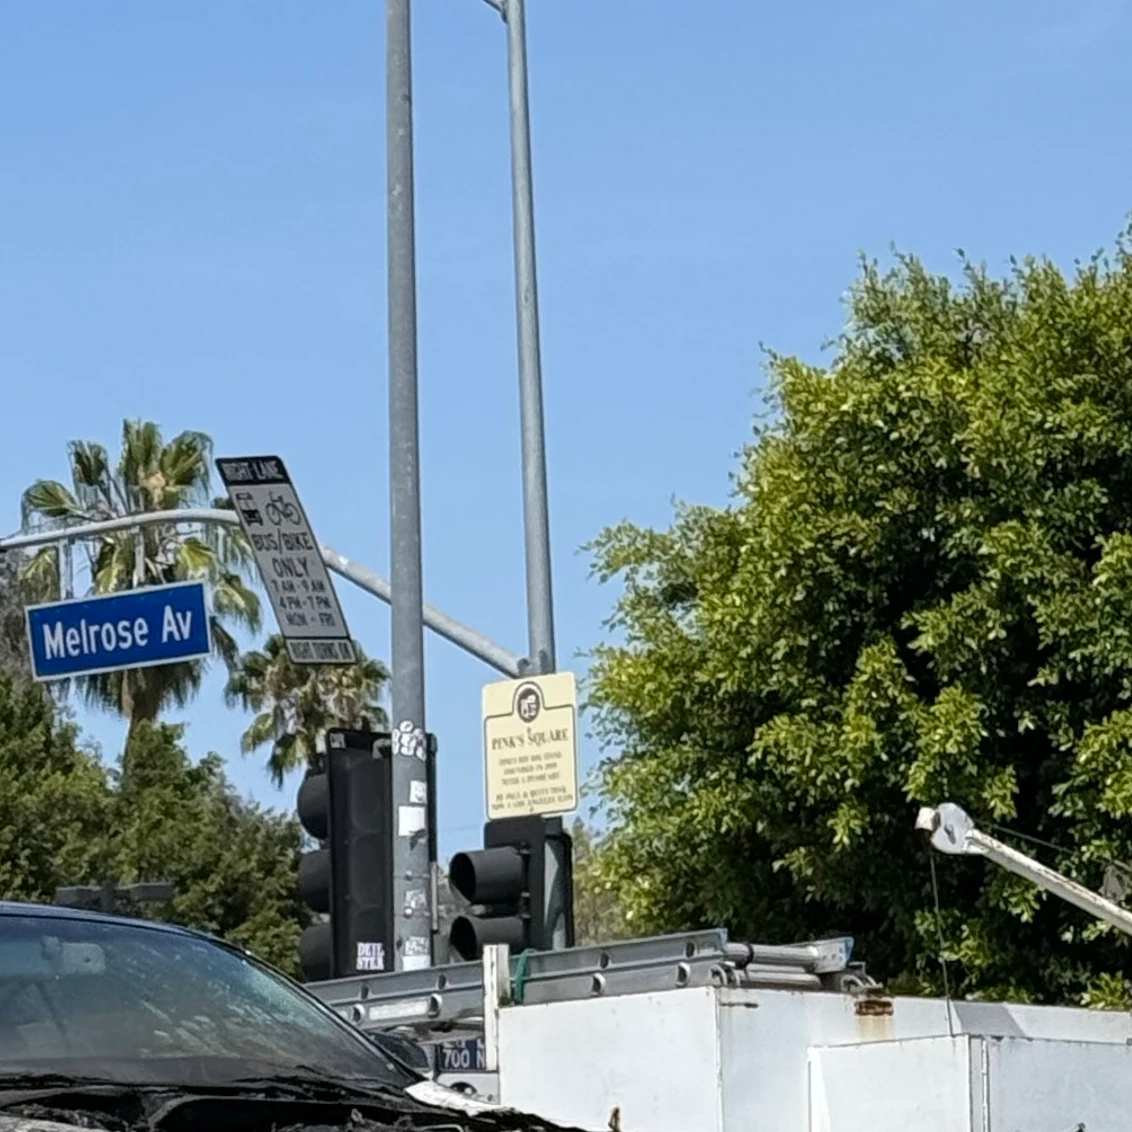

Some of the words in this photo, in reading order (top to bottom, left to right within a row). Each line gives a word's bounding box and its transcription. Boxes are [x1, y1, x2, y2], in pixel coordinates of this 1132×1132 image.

[250, 528, 314, 555] BUS/BIKE
[271, 557, 310, 578] ONLY
[42, 617, 150, 661] Melrose
[161, 604, 192, 644] Av
[527, 728, 569, 747] SQUARE
[443, 1048, 470, 1069] 700
